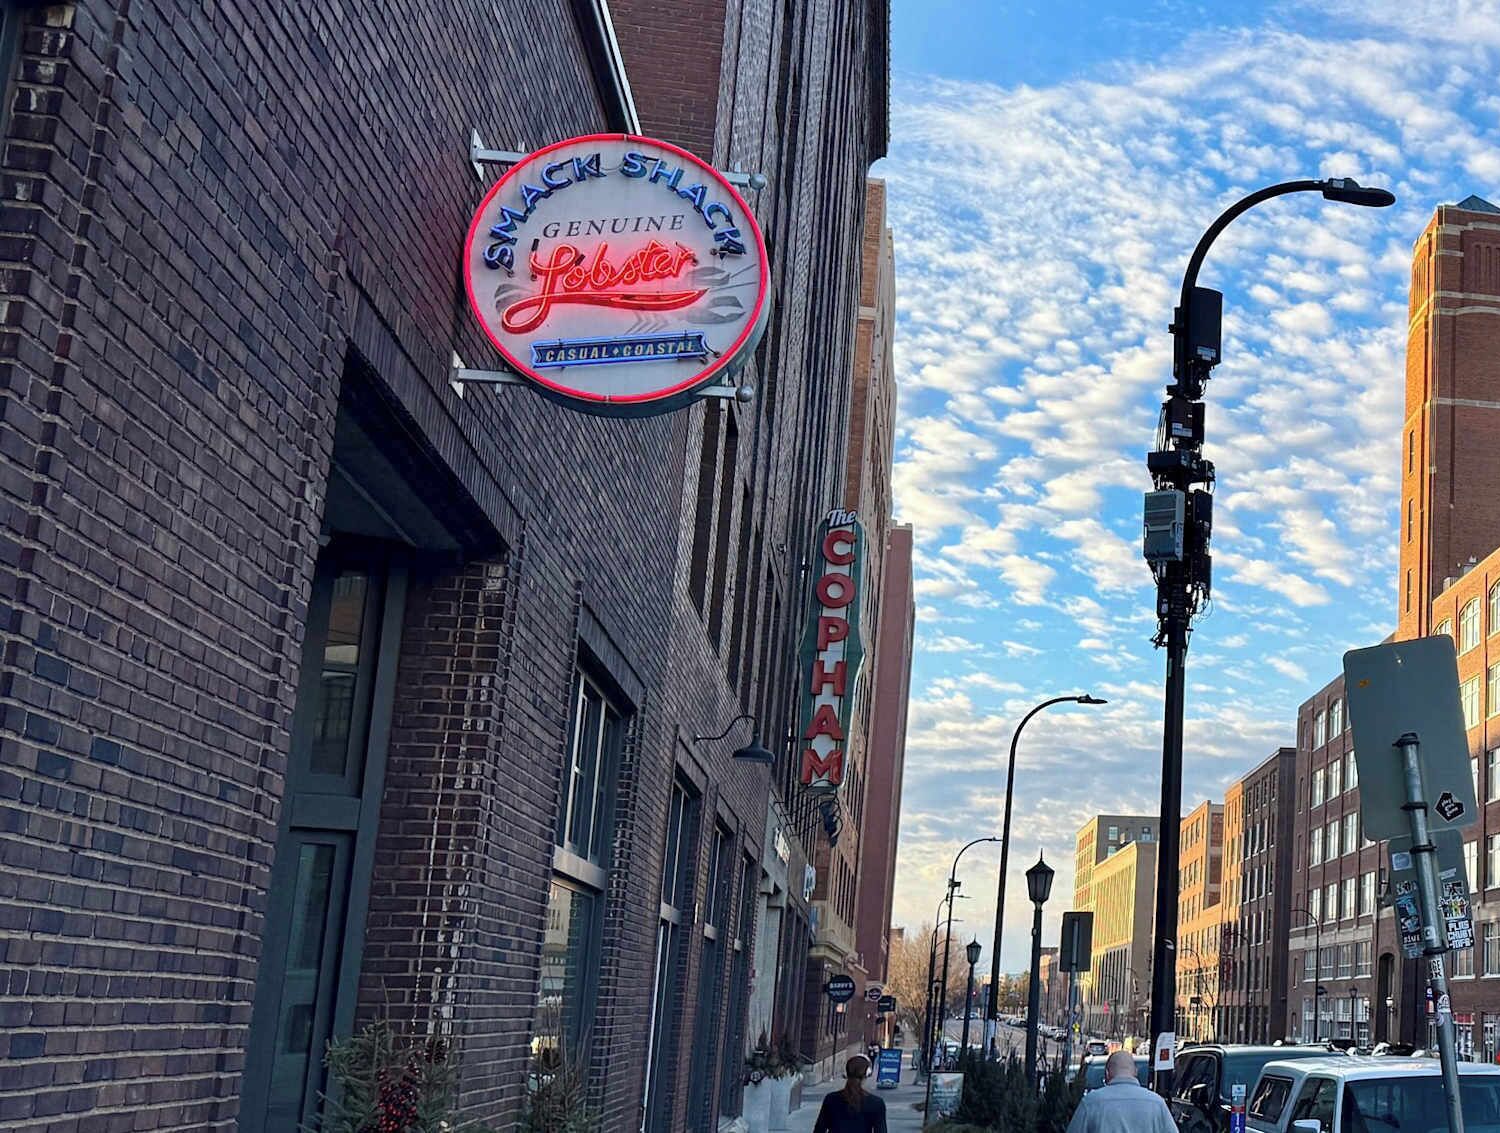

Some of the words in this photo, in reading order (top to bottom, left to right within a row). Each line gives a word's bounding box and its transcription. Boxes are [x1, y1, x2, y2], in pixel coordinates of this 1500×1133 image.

[482, 152, 606, 274] SMACK
[622, 150, 747, 258] SHACK
[542, 214, 686, 239] GENUINE
[501, 238, 705, 334] Lobster
[545, 346, 610, 361] CASUAL
[622, 340, 696, 358] COASTAL
[826, 508, 857, 527] The
[801, 529, 856, 785] COPHAM
